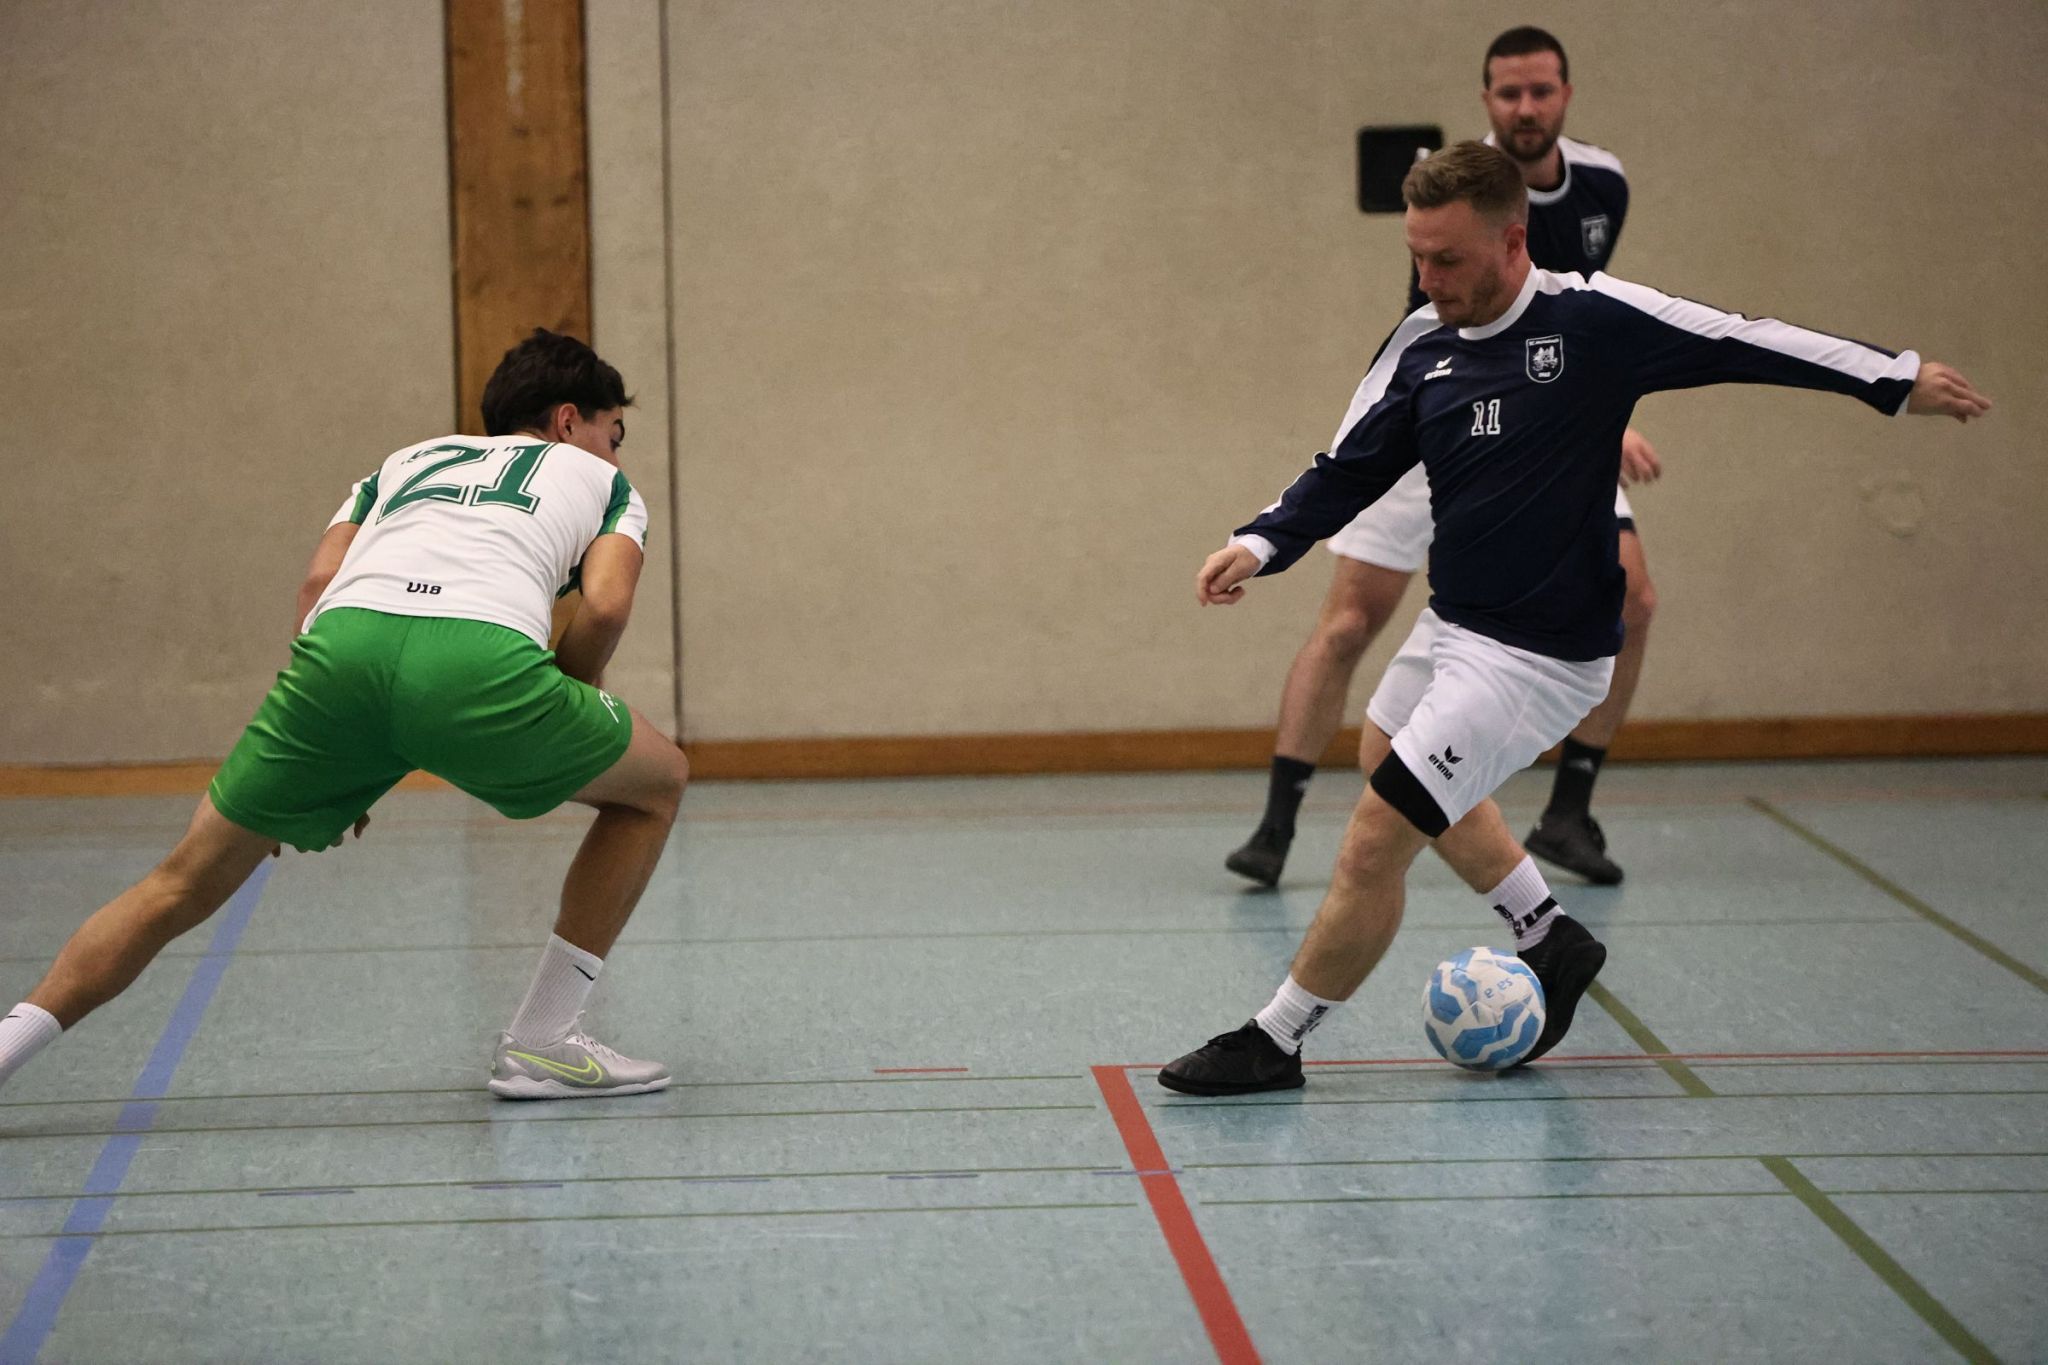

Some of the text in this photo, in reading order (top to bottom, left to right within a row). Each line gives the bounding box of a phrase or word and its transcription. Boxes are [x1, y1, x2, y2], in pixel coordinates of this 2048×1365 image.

[1470, 398, 1501, 436] 11
[375, 441, 557, 526] 21
[406, 581, 442, 595] U18
[1428, 753, 1454, 781] erima
